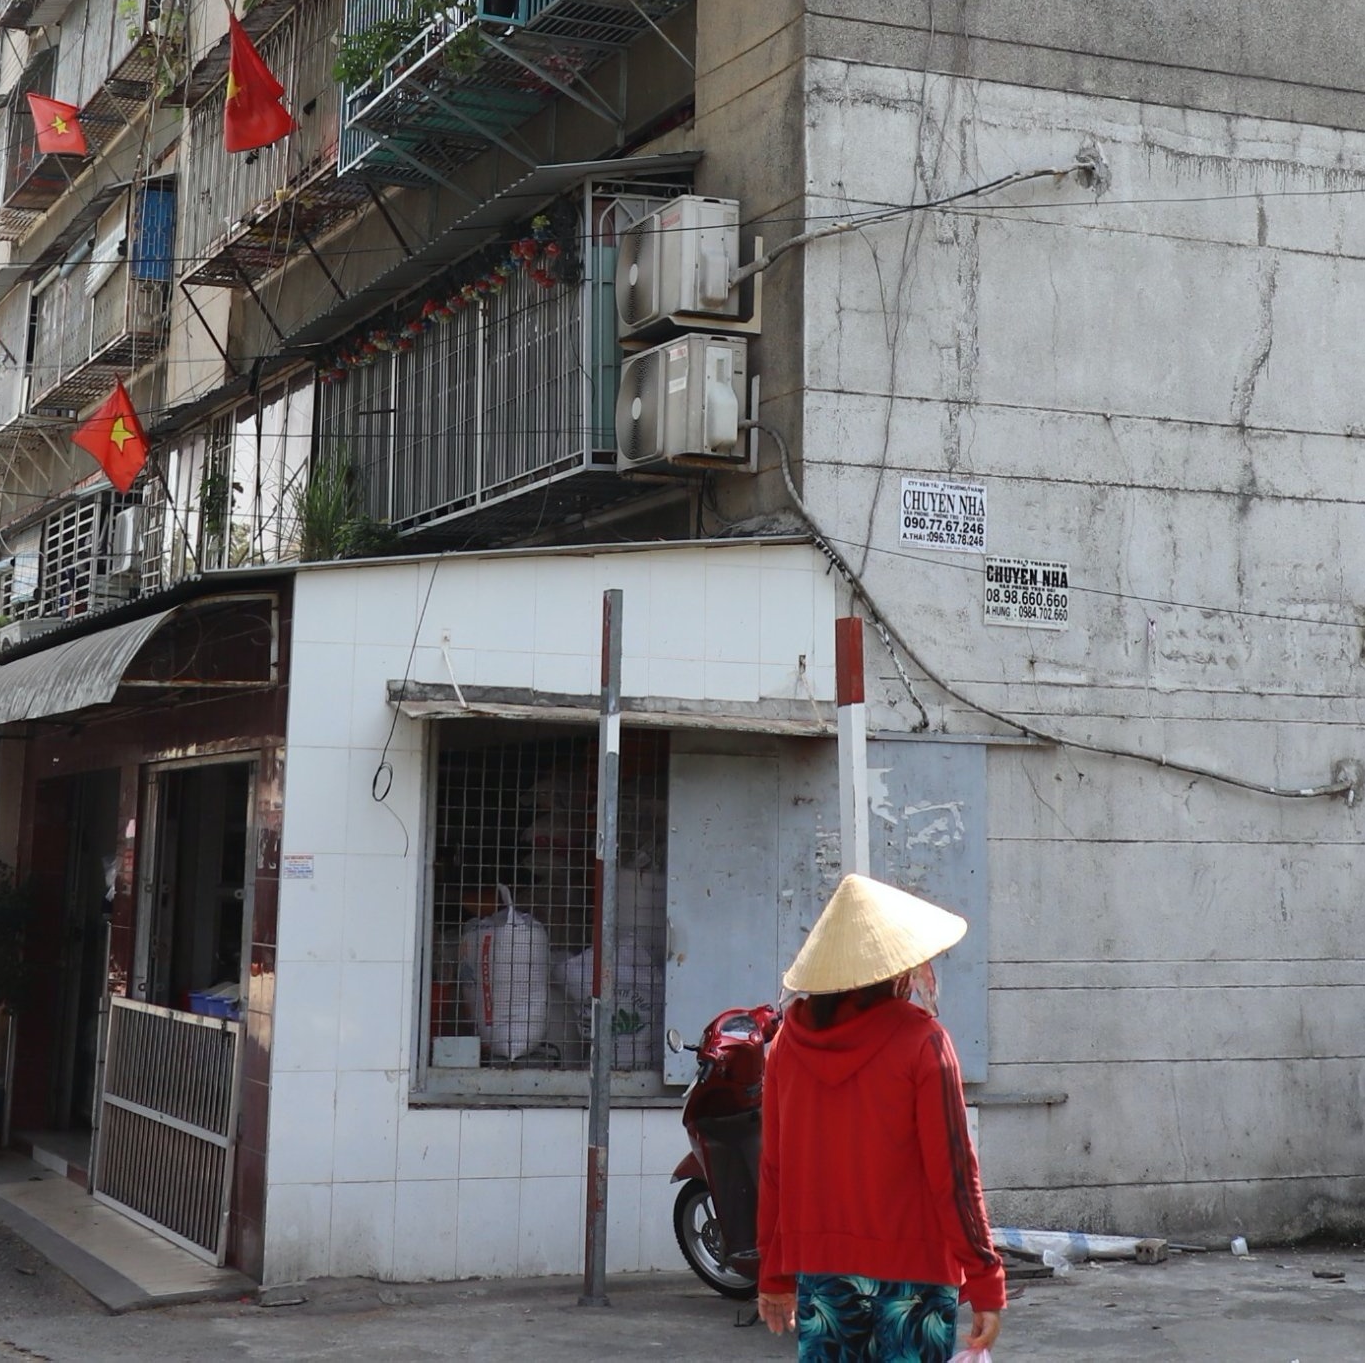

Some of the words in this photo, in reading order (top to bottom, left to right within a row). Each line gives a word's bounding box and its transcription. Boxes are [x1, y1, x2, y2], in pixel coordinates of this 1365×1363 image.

[904, 516, 985, 535] 090.77.67.246
[986, 562, 1038, 586] CHUYỂN
[1042, 568, 1068, 589] NHÀ
[986, 588, 1068, 609] 08.98.660.660
